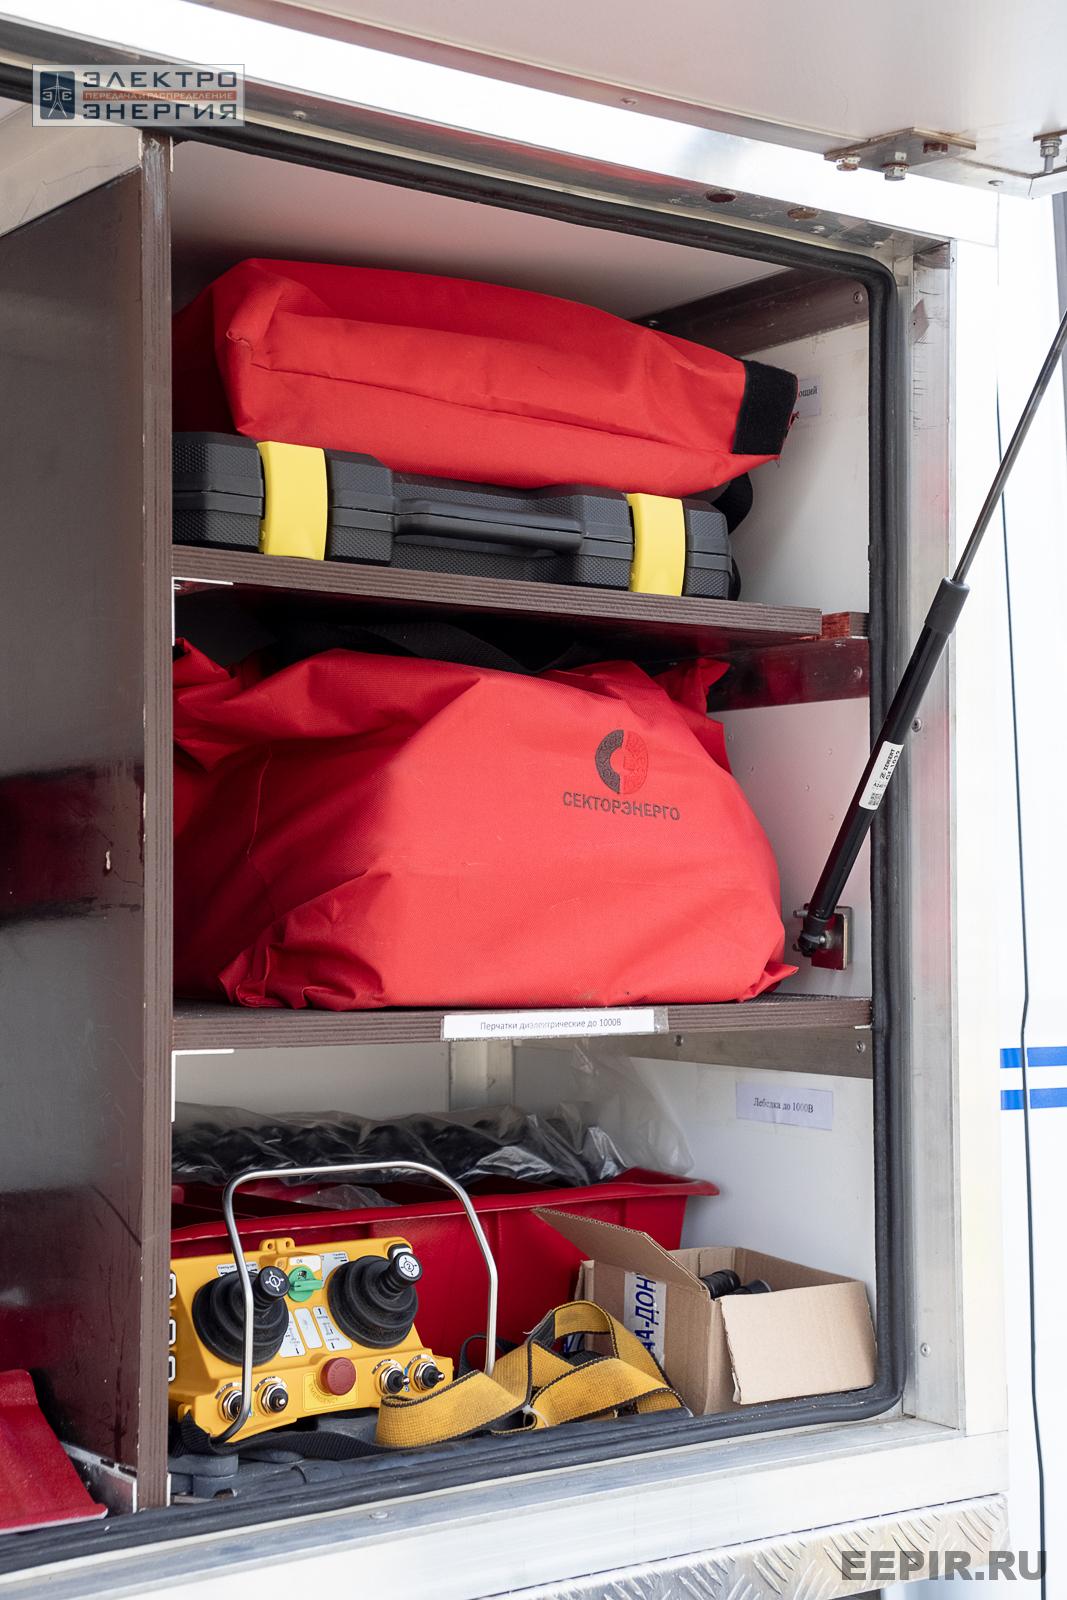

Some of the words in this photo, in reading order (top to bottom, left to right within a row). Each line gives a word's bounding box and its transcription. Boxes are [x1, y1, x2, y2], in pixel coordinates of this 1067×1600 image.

[563, 791, 680, 821] СЕКТОРЭНЕРГО
[480, 1021, 518, 1031] Перчатки
[587, 1018, 598, 1028] до
[782, 1103, 791, 1111] до
[792, 1102, 814, 1114] 1000В
